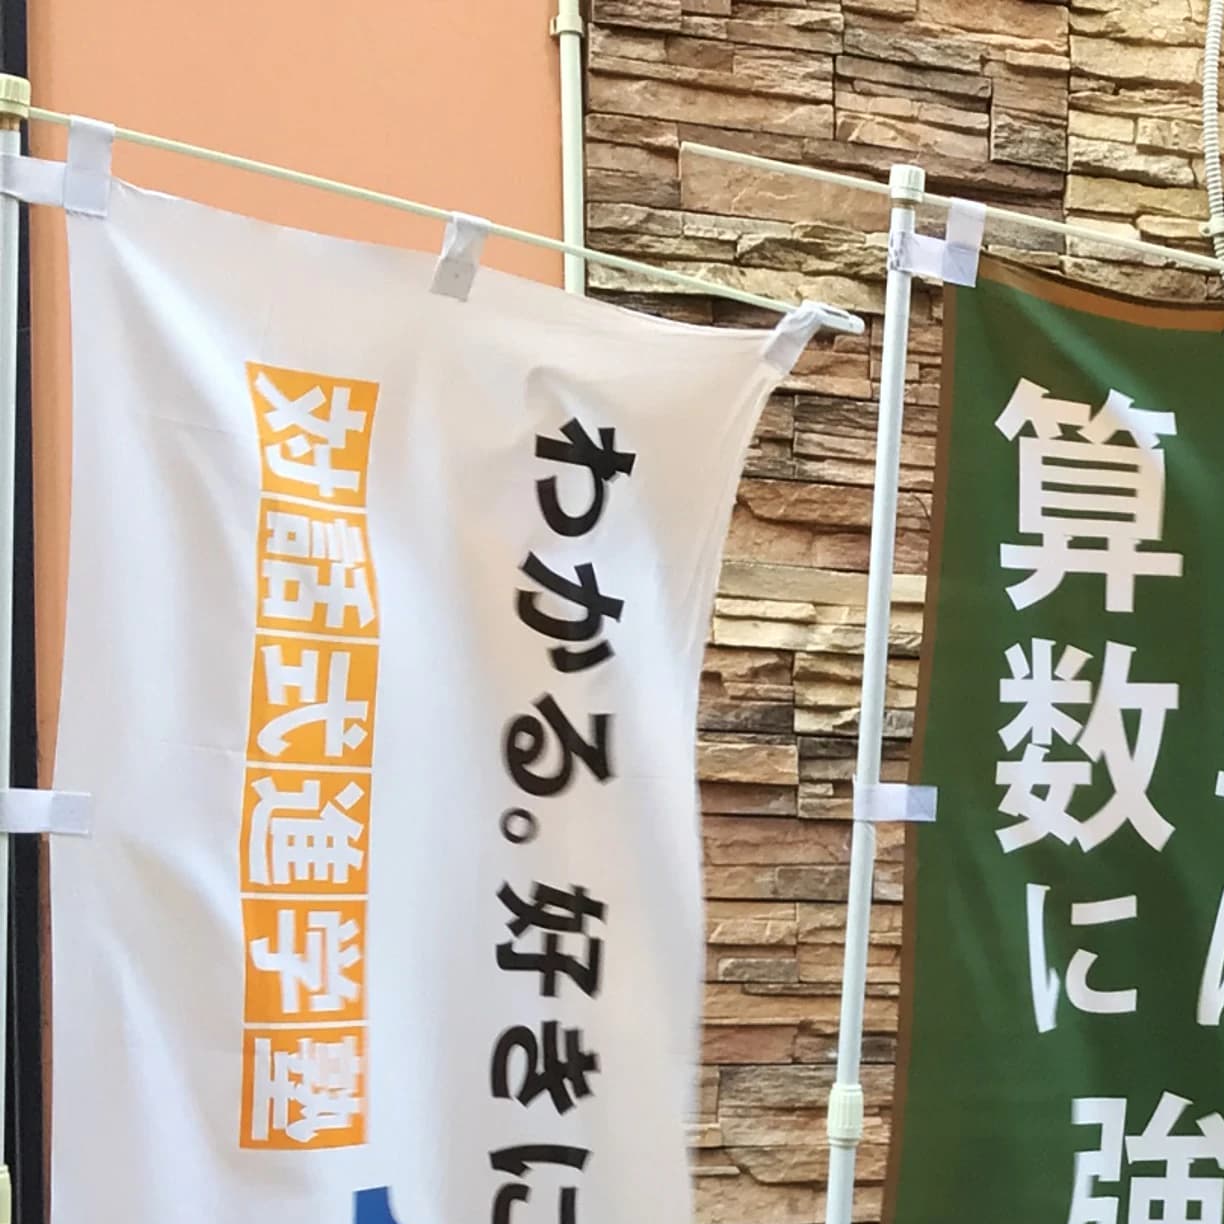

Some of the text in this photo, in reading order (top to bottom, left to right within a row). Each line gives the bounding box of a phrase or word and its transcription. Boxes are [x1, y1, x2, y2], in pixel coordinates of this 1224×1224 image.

[246, 366, 379, 1149] 対話式進学塾
